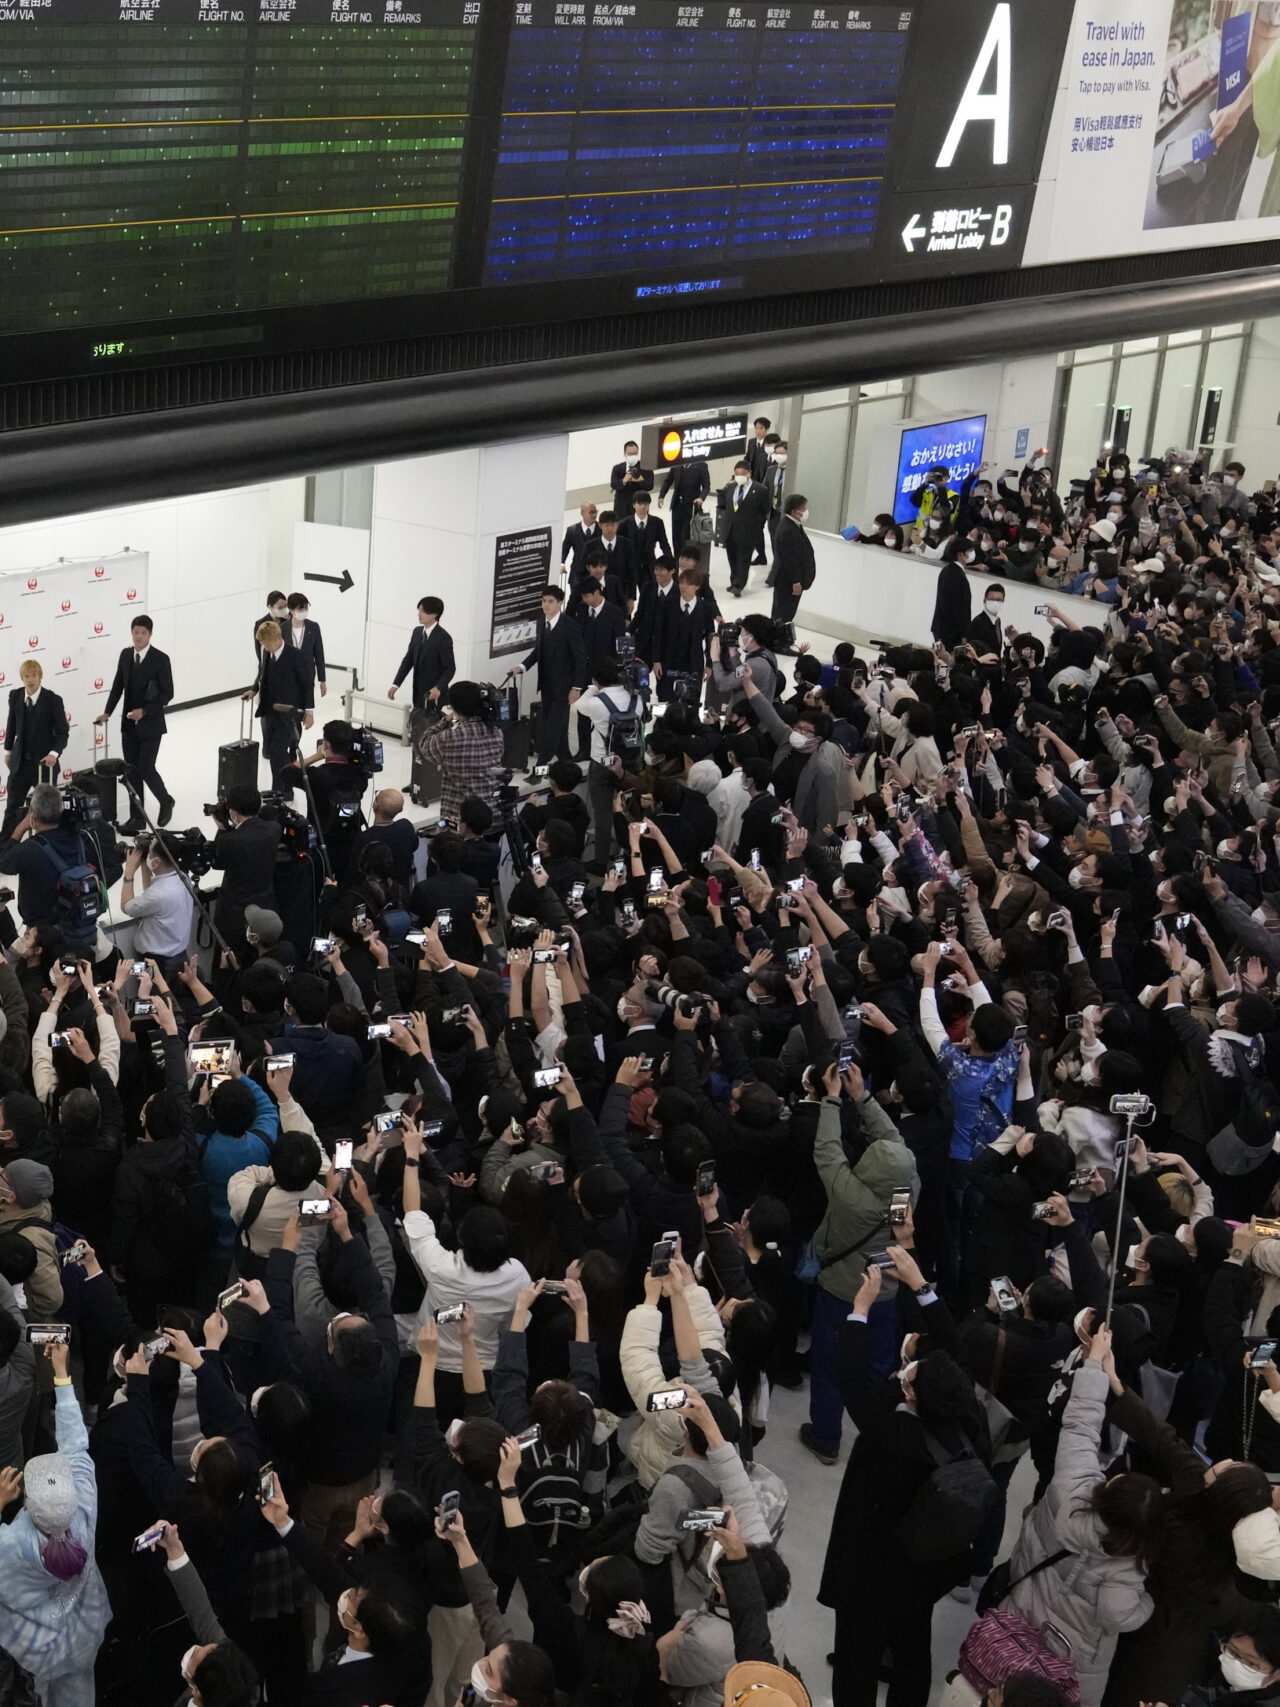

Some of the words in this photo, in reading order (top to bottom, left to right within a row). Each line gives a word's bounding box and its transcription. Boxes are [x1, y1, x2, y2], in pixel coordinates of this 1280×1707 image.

[463, 15, 479, 24] EXIT
[1086, 21, 1119, 41] Travel
[1121, 21, 1145, 41] with
[1082, 51, 1107, 67] ease
[1109, 48, 1120, 66] in
[1121, 48, 1156, 70] Japan.
[935, 3, 1011, 168] A
[1079, 80, 1092, 95] Tap
[1094, 82, 1101, 92] to
[1102, 83, 1116, 95] pay
[1117, 79, 1133, 91] with
[1134, 79, 1151, 91] Visa.
[1225, 69, 1241, 91] VISA
[990, 204, 1013, 246] B
[927, 234, 957, 252] Arrival
[957, 232, 985, 250] Lobby
[683, 425, 724, 443] 入れません
[682, 448, 692, 458] No
[692, 445, 711, 457] Entry
[911, 438, 976, 467] おかえりなさい!
